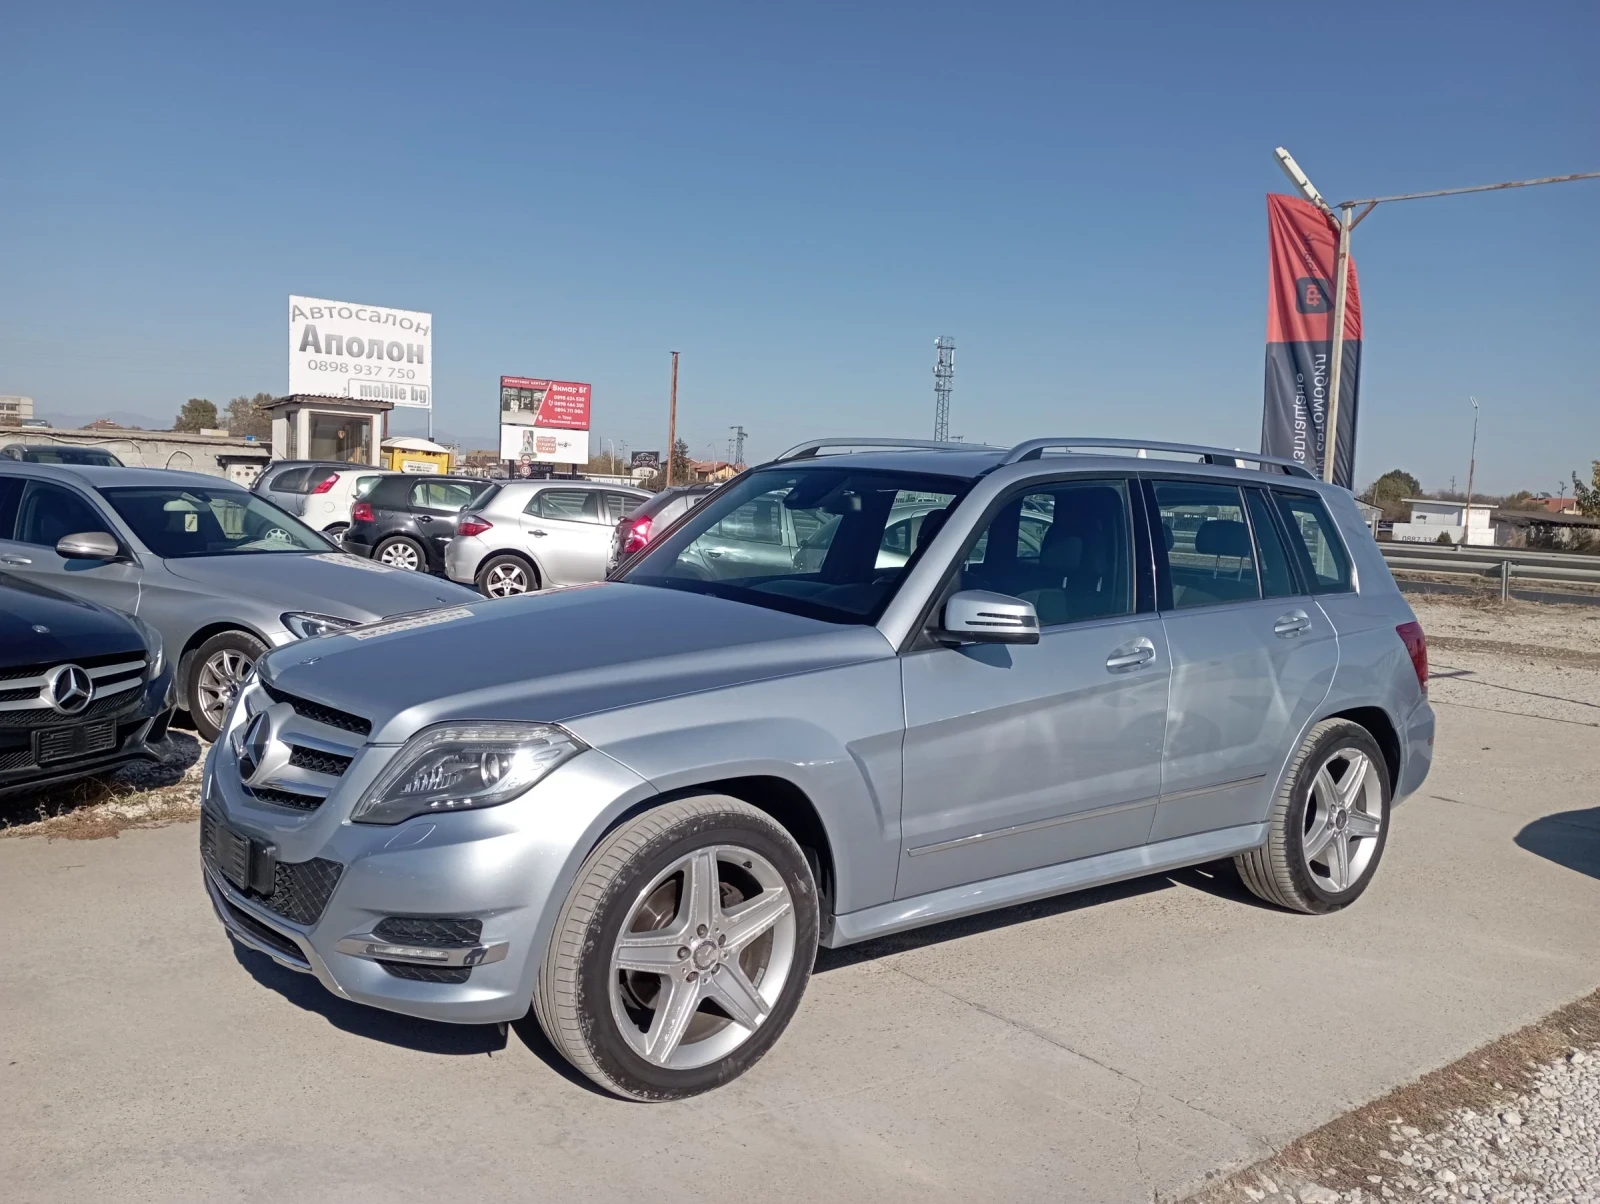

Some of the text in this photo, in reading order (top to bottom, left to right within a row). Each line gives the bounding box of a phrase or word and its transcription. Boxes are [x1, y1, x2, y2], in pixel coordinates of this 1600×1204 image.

[292, 304, 430, 336] Автосалон
[299, 324, 424, 364] Аполон
[308, 360, 415, 379] 0898 937 750
[360, 384, 407, 400] mobile
